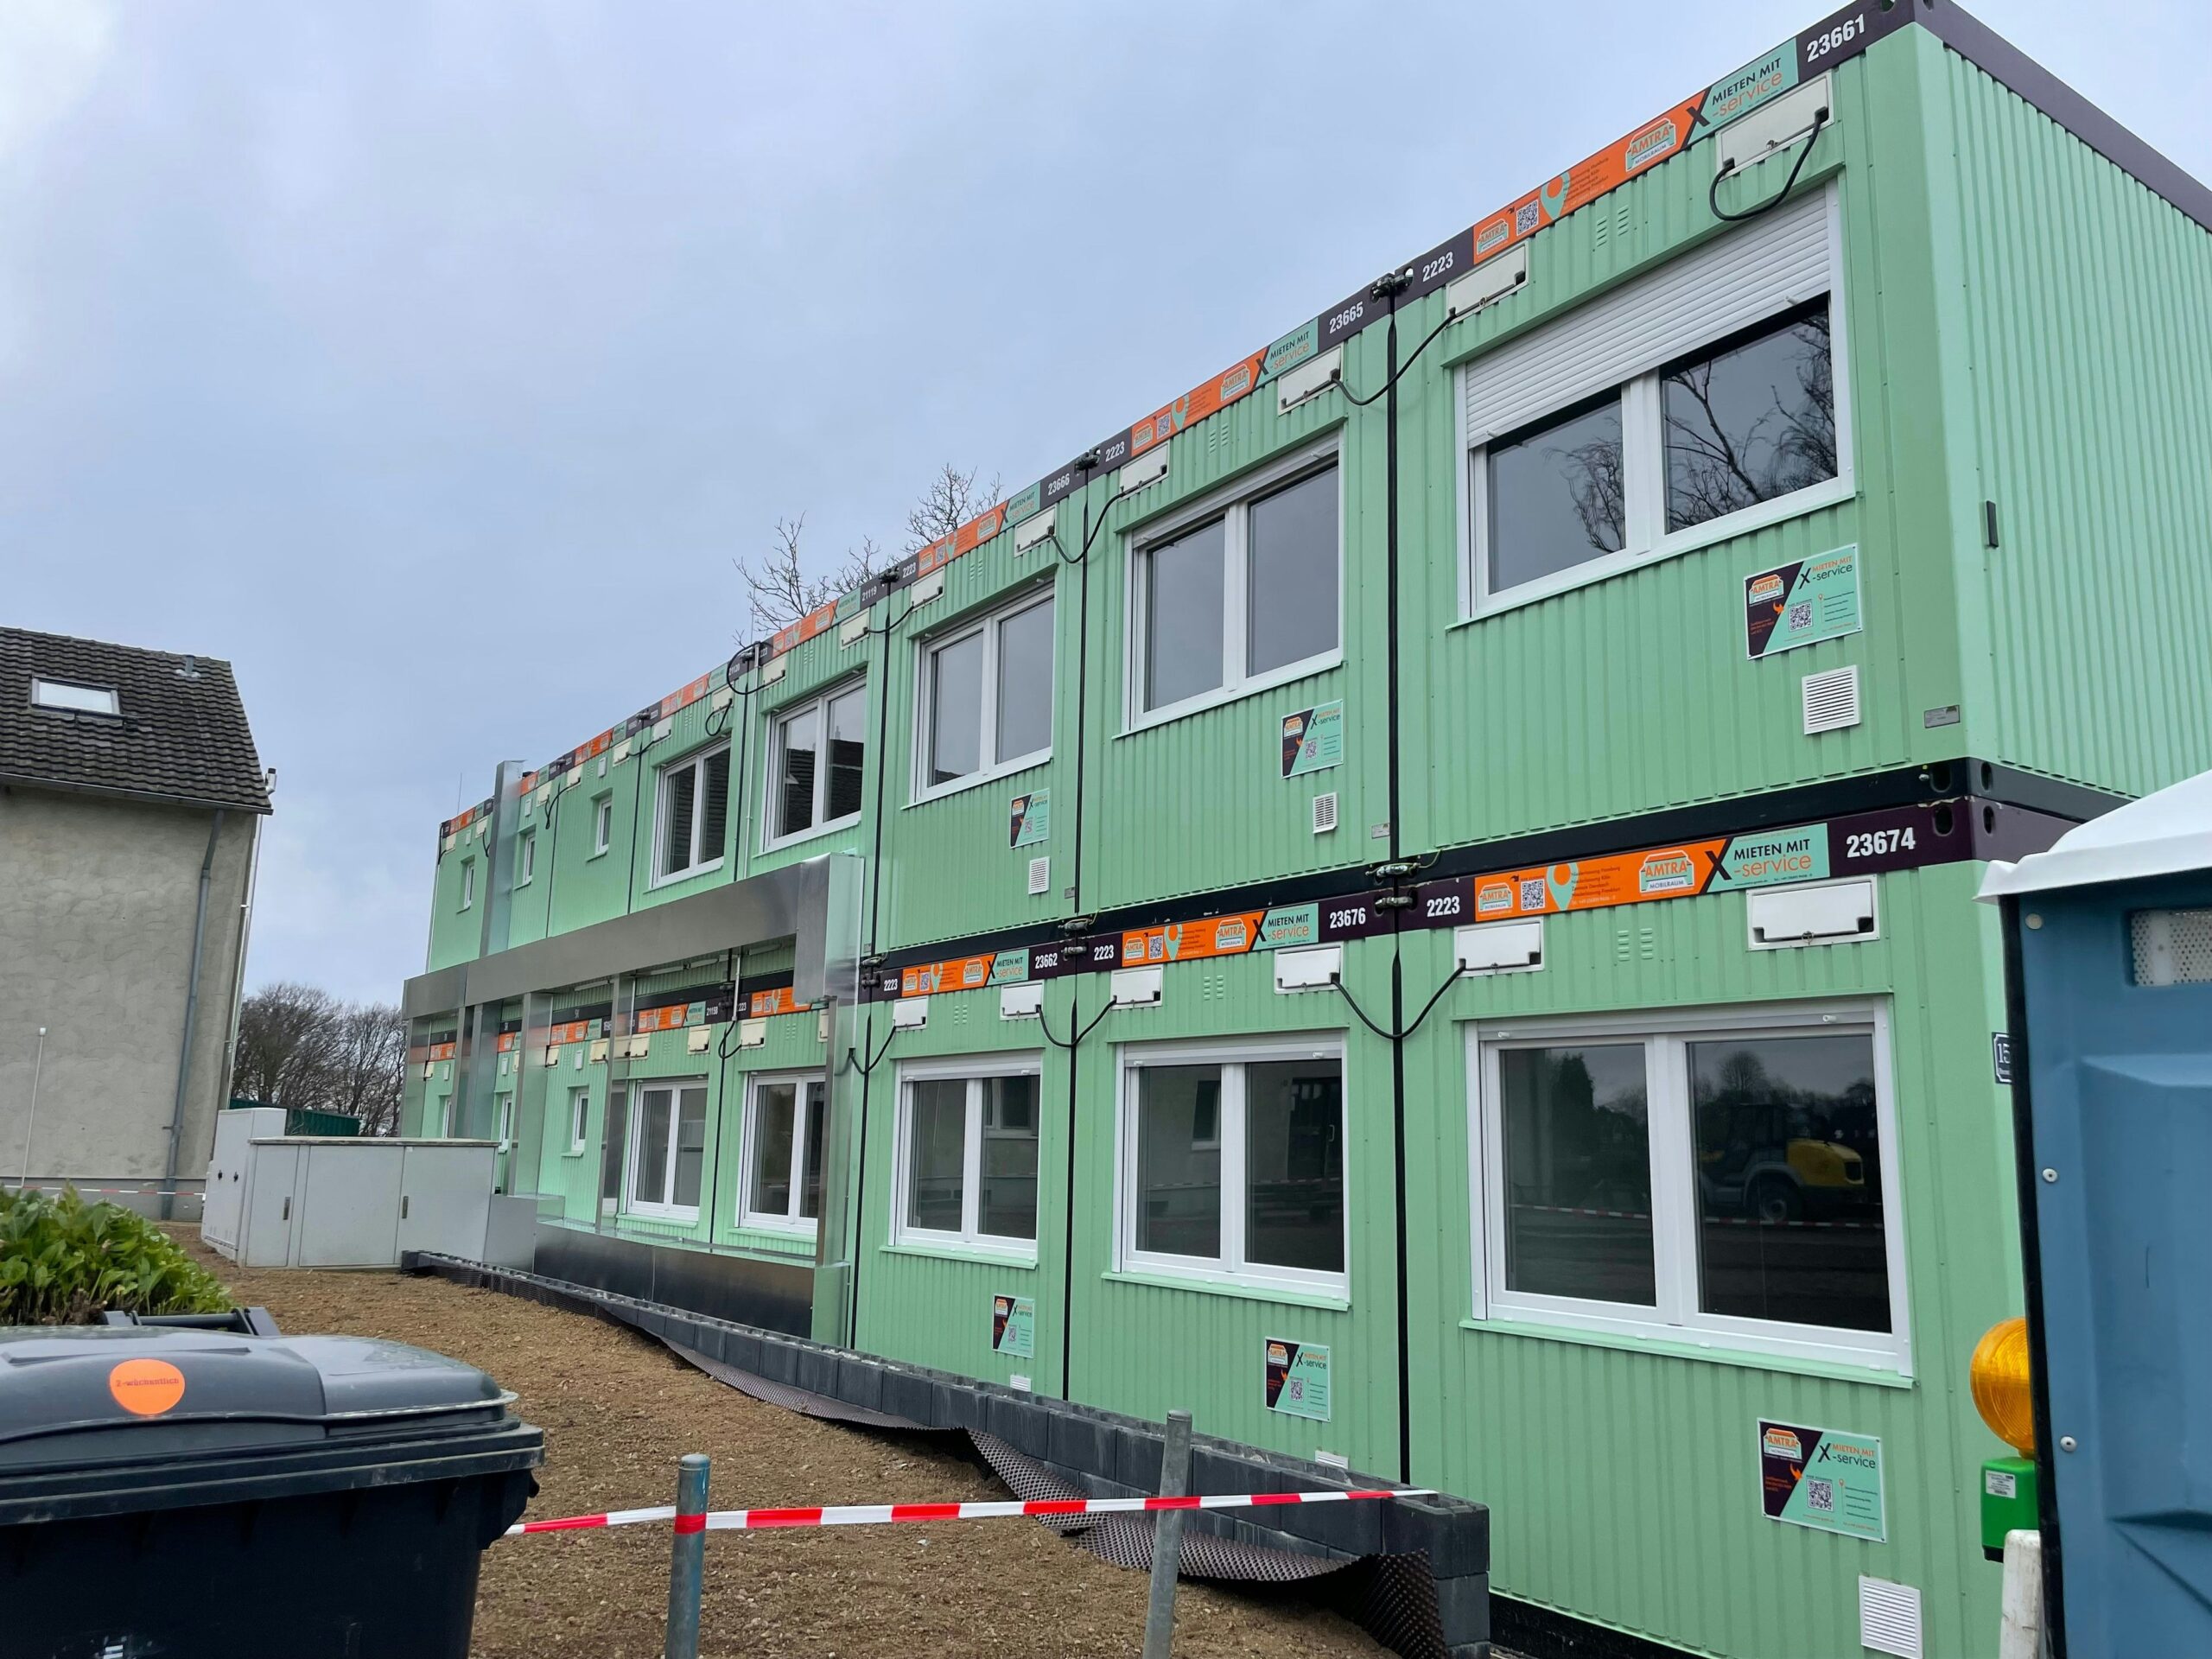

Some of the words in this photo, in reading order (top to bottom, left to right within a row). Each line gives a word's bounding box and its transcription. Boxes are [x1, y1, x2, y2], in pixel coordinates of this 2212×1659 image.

[1807, 14, 1865, 62] 23661
[1712, 73, 1756, 105] MIETEN
[1759, 58, 1781, 79] MIT
[1630, 126, 1670, 156] AMTRA
[1480, 224, 1506, 244] AMTRA
[1422, 251, 1453, 282] 2223
[1329, 302, 1363, 334] 23665
[1270, 340, 1295, 359] MIETEN
[1297, 331, 1309, 343] MIT
[1105, 441, 1125, 462] 2223
[1047, 473, 1070, 496] 23666
[902, 563, 916, 578] 2223
[1812, 561, 1839, 572] MIETEN
[1840, 556, 1853, 564] MIT
[1752, 580, 1779, 594] AMTRA
[1734, 843, 1782, 861] MIETEN
[1786, 839, 1810, 853] MIT
[1846, 827, 1916, 858] 23674
[1645, 860, 1688, 877] AMTRA
[1649, 880, 1684, 889] MOBILRAUM
[1482, 890, 1509, 901] AMTRA
[1427, 895, 1460, 917] 2223
[1268, 917, 1294, 928] MIETEN
[1295, 914, 1309, 923] MIT
[1329, 907, 1366, 929] 23676
[1218, 925, 1243, 938] AMTRA
[1034, 952, 1058, 969] 23662
[1094, 944, 1115, 961] 2223
[997, 958, 1014, 967] MIETEN
[1014, 957, 1023, 965] MIT
[883, 978, 898, 991] 2223
[1767, 1435, 1796, 1448] AMTRA
[1833, 1444, 1859, 1455] MIETEN
[1861, 1448, 1874, 1457] MIT
